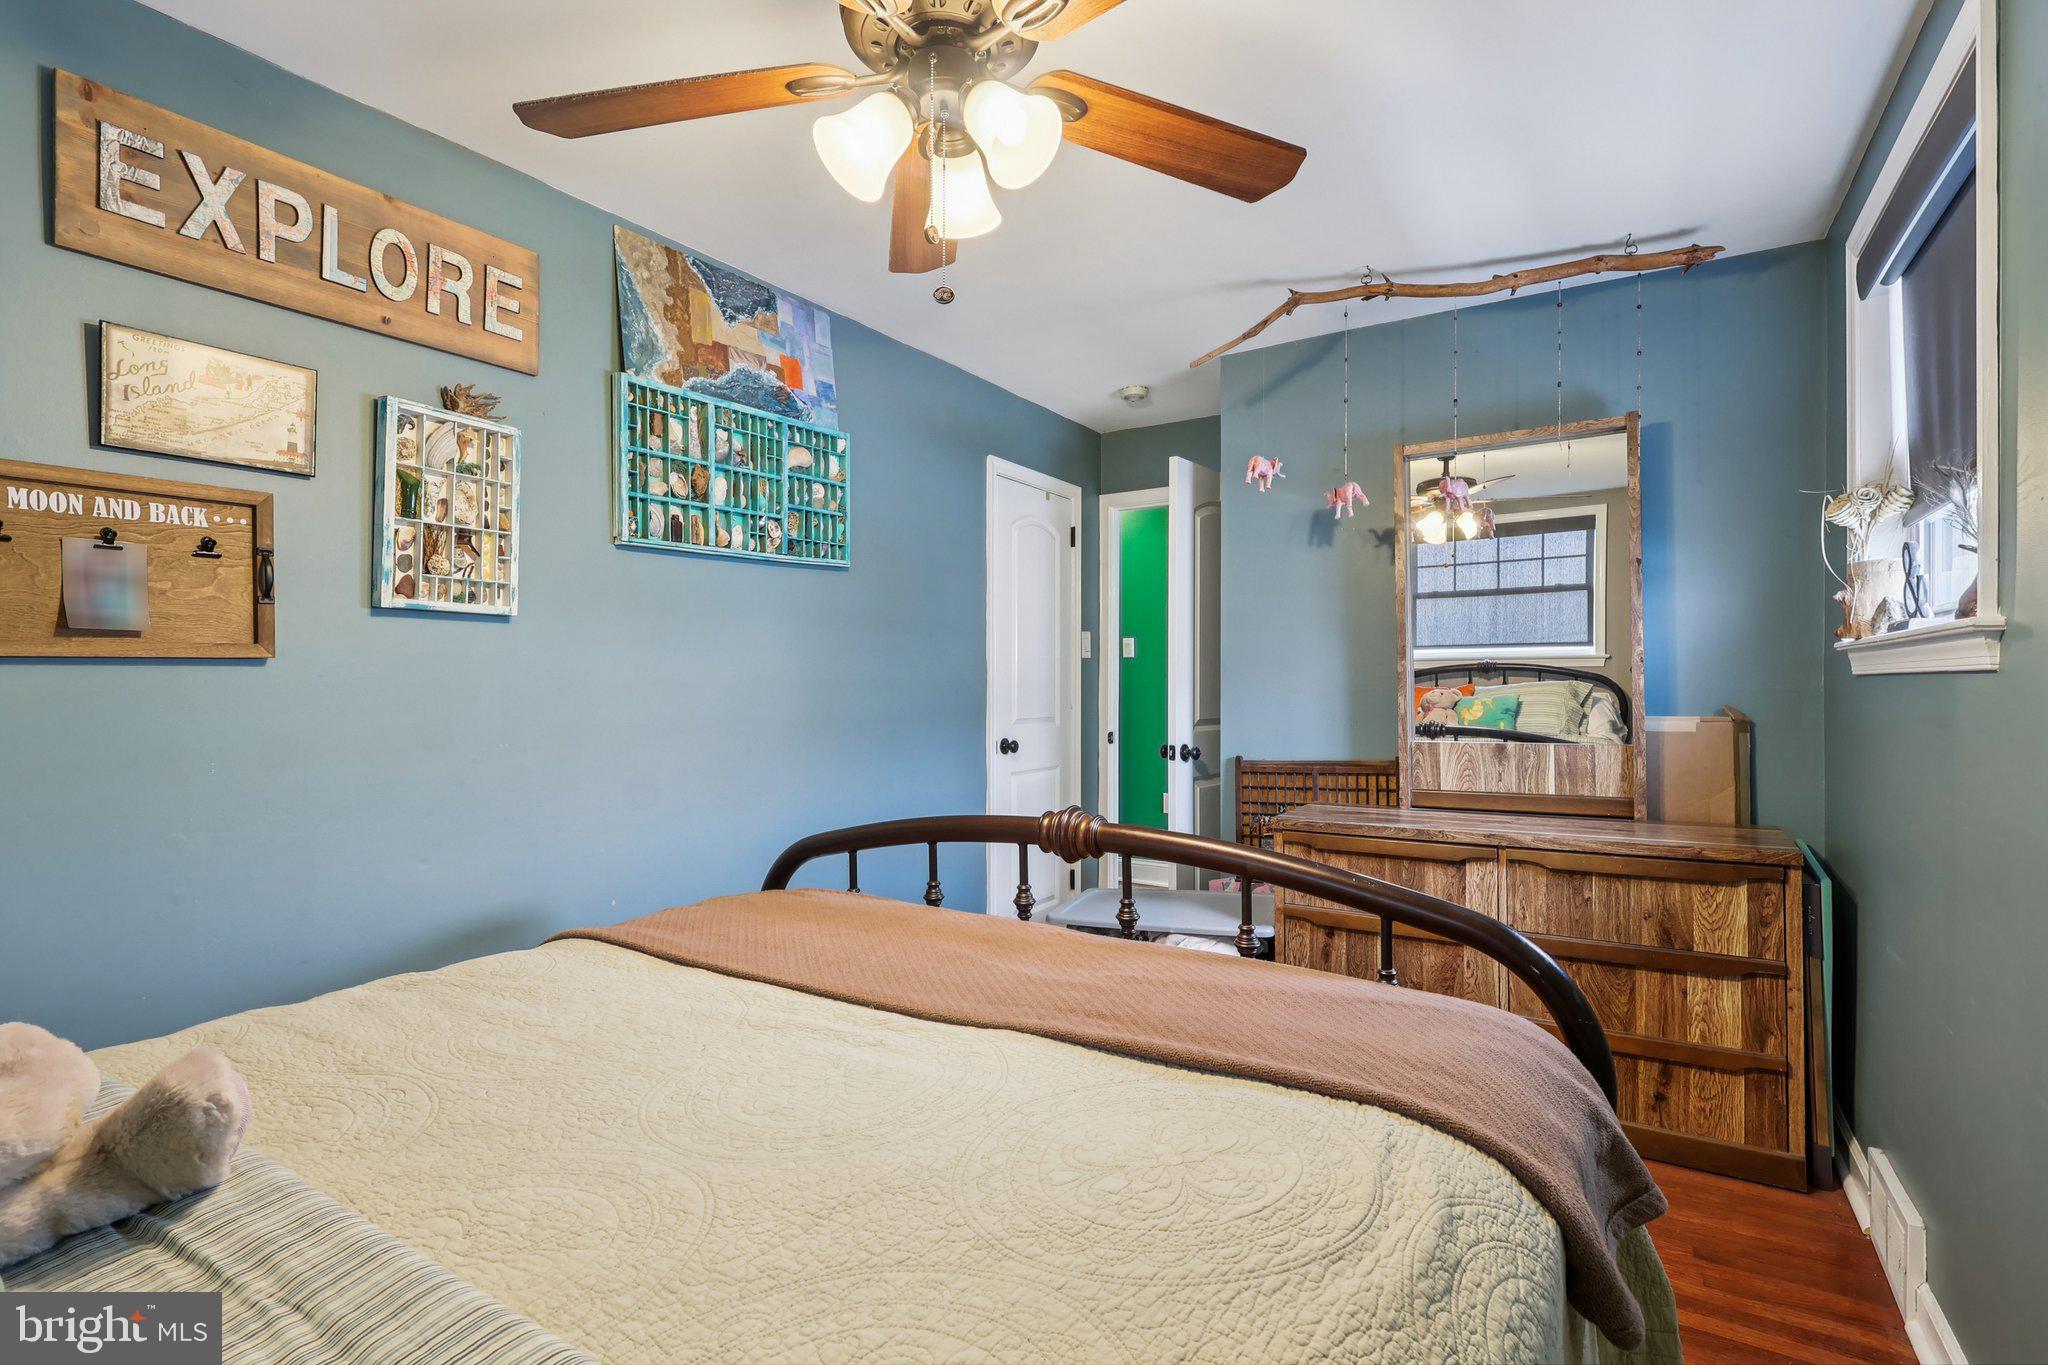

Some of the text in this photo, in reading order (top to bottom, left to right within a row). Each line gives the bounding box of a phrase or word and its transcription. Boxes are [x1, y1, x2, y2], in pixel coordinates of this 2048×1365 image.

[97, 118, 524, 342] EXPLORE
[109, 358, 169, 380] Long
[122, 370, 197, 401] Island
[6, 486, 84, 516] MOON
[92, 496, 142, 521] AND
